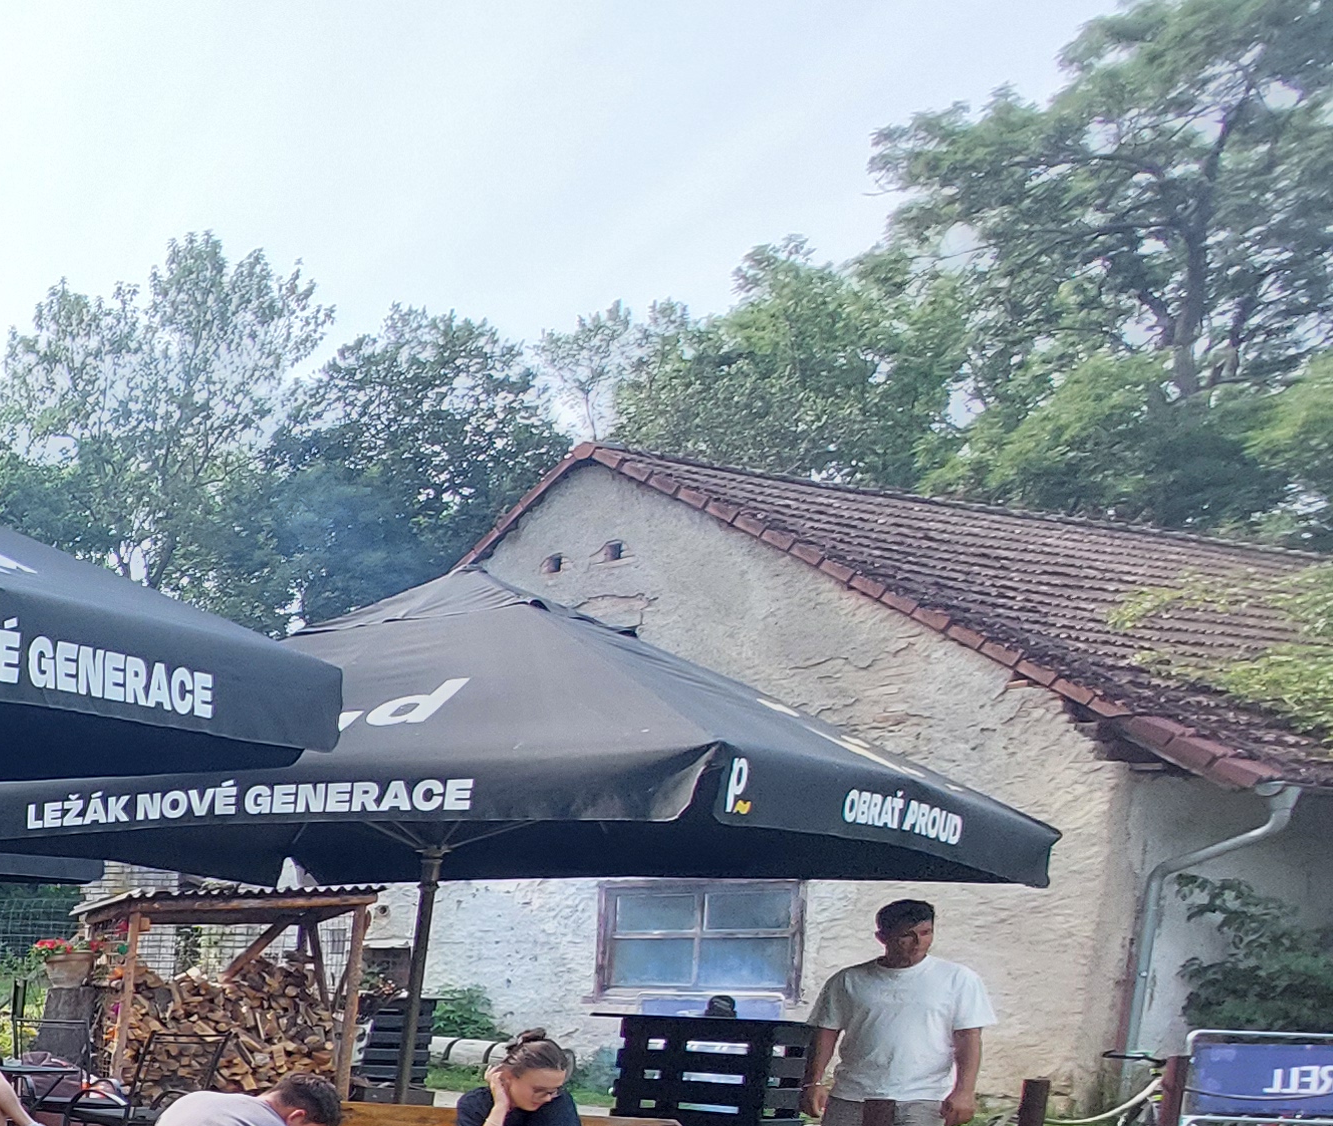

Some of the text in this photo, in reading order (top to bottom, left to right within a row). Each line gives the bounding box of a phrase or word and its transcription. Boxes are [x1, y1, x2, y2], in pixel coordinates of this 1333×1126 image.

[27, 635, 214, 719] GENERACE
[27, 778, 475, 831] LEŽÁK NOVÉ GENERACE
[842, 789, 963, 846] OBRAŤ PROUD
